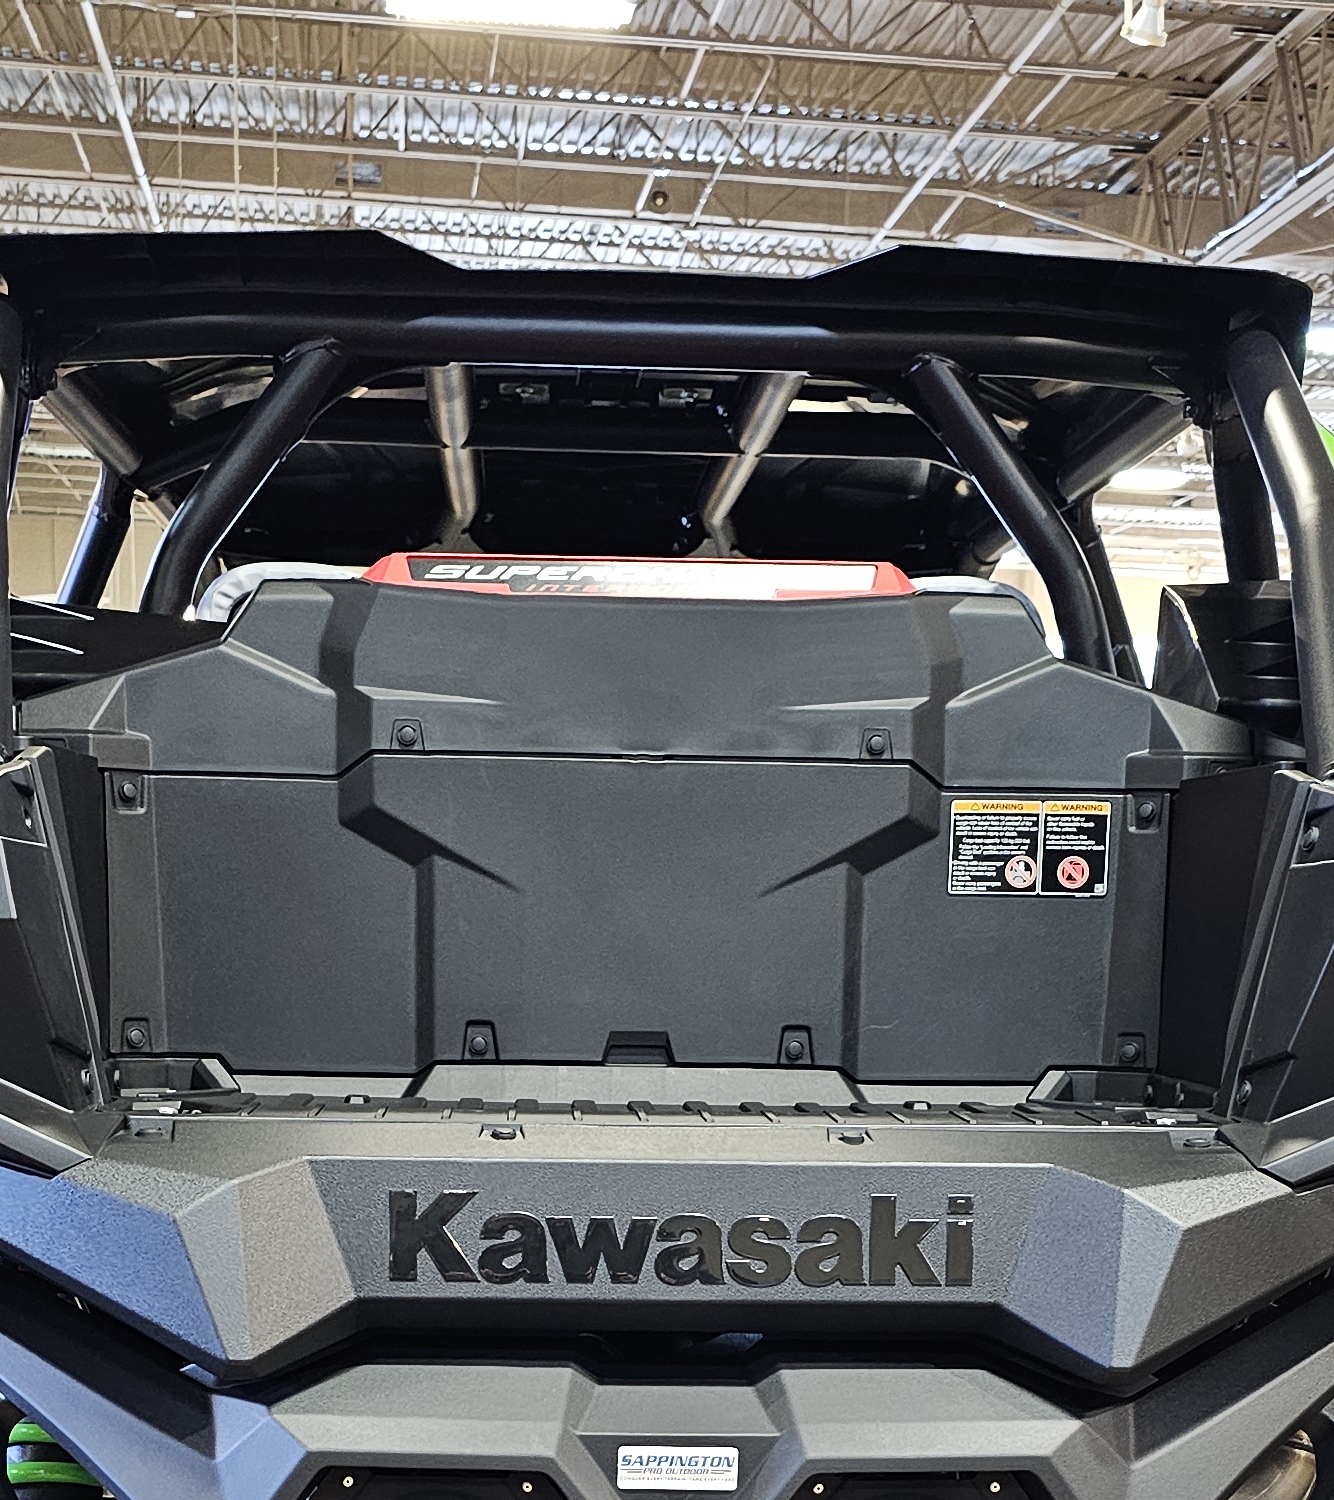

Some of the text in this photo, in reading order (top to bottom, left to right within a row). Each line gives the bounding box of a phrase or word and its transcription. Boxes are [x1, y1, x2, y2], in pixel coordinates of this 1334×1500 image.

[981, 803, 1024, 811] WARNING
[1061, 804, 1103, 812] WARNING
[387, 1189, 975, 1287] Kawasaki
[620, 1454, 736, 1468] SAPPINGTON
